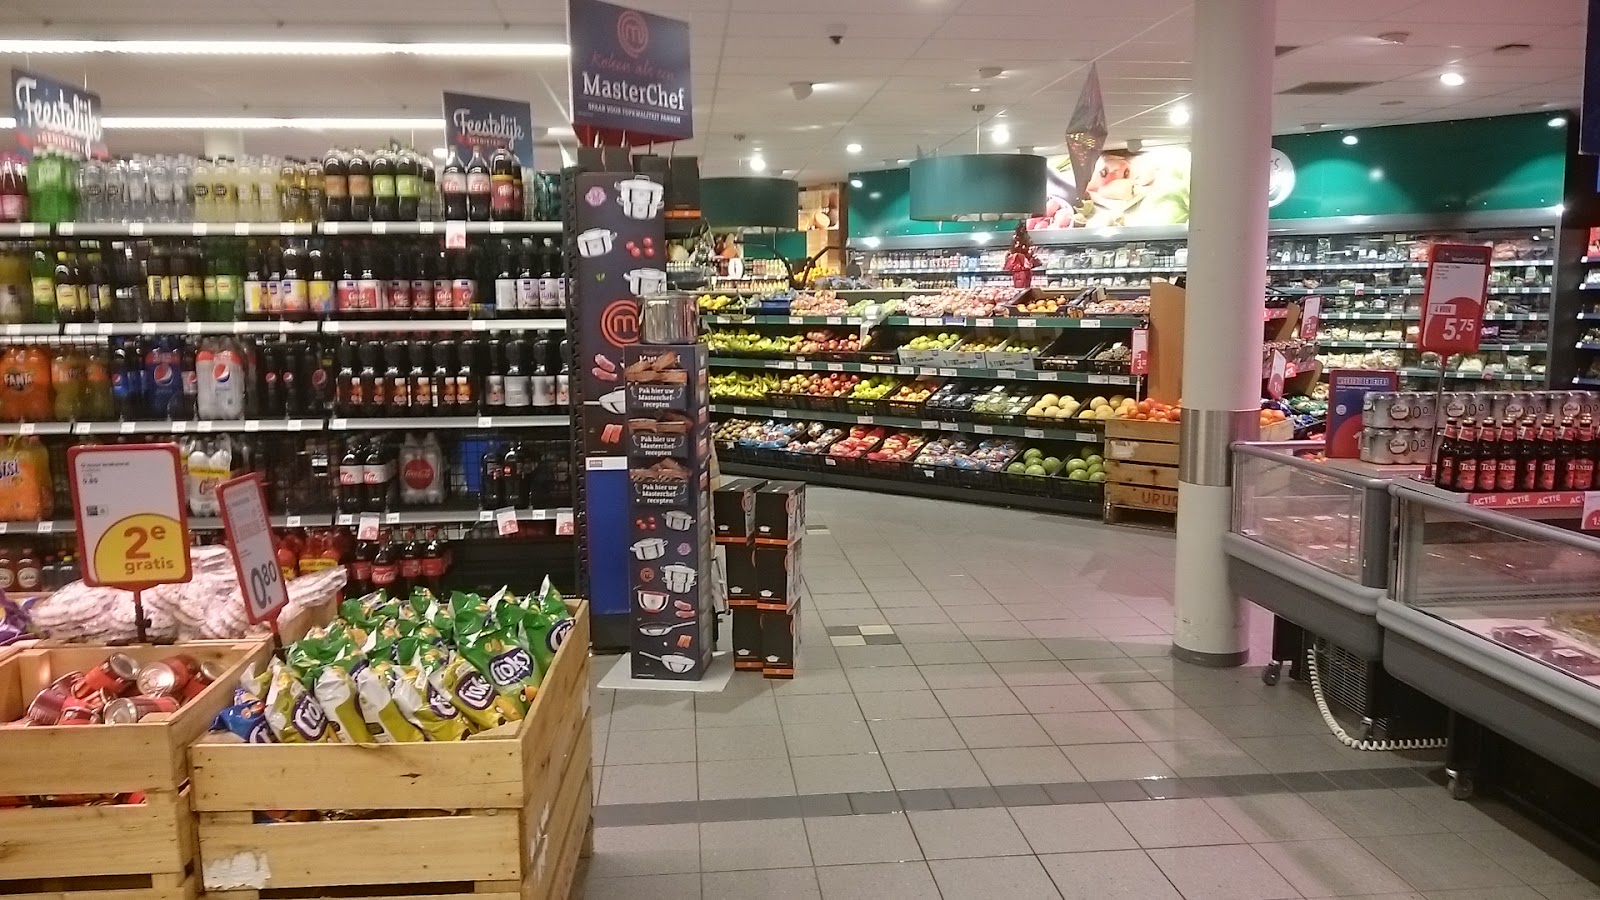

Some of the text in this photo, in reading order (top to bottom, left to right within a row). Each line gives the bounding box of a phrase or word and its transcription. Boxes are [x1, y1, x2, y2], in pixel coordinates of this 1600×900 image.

[582, 71, 685, 111] MasterChef
[587, 102, 606, 113] SPAAR
[606, 104, 621, 115] VOOR
[15, 76, 102, 160] Feestelijk
[453, 108, 525, 151] Feestelijk
[1442, 317, 1475, 341] 5.75
[3, 372, 34, 387] FANTA
[1473, 494, 1497, 507] ACTIE
[1505, 494, 1530, 506] ACTIE
[1537, 494, 1561, 505] ACTIE
[124, 557, 174, 575] gratis
